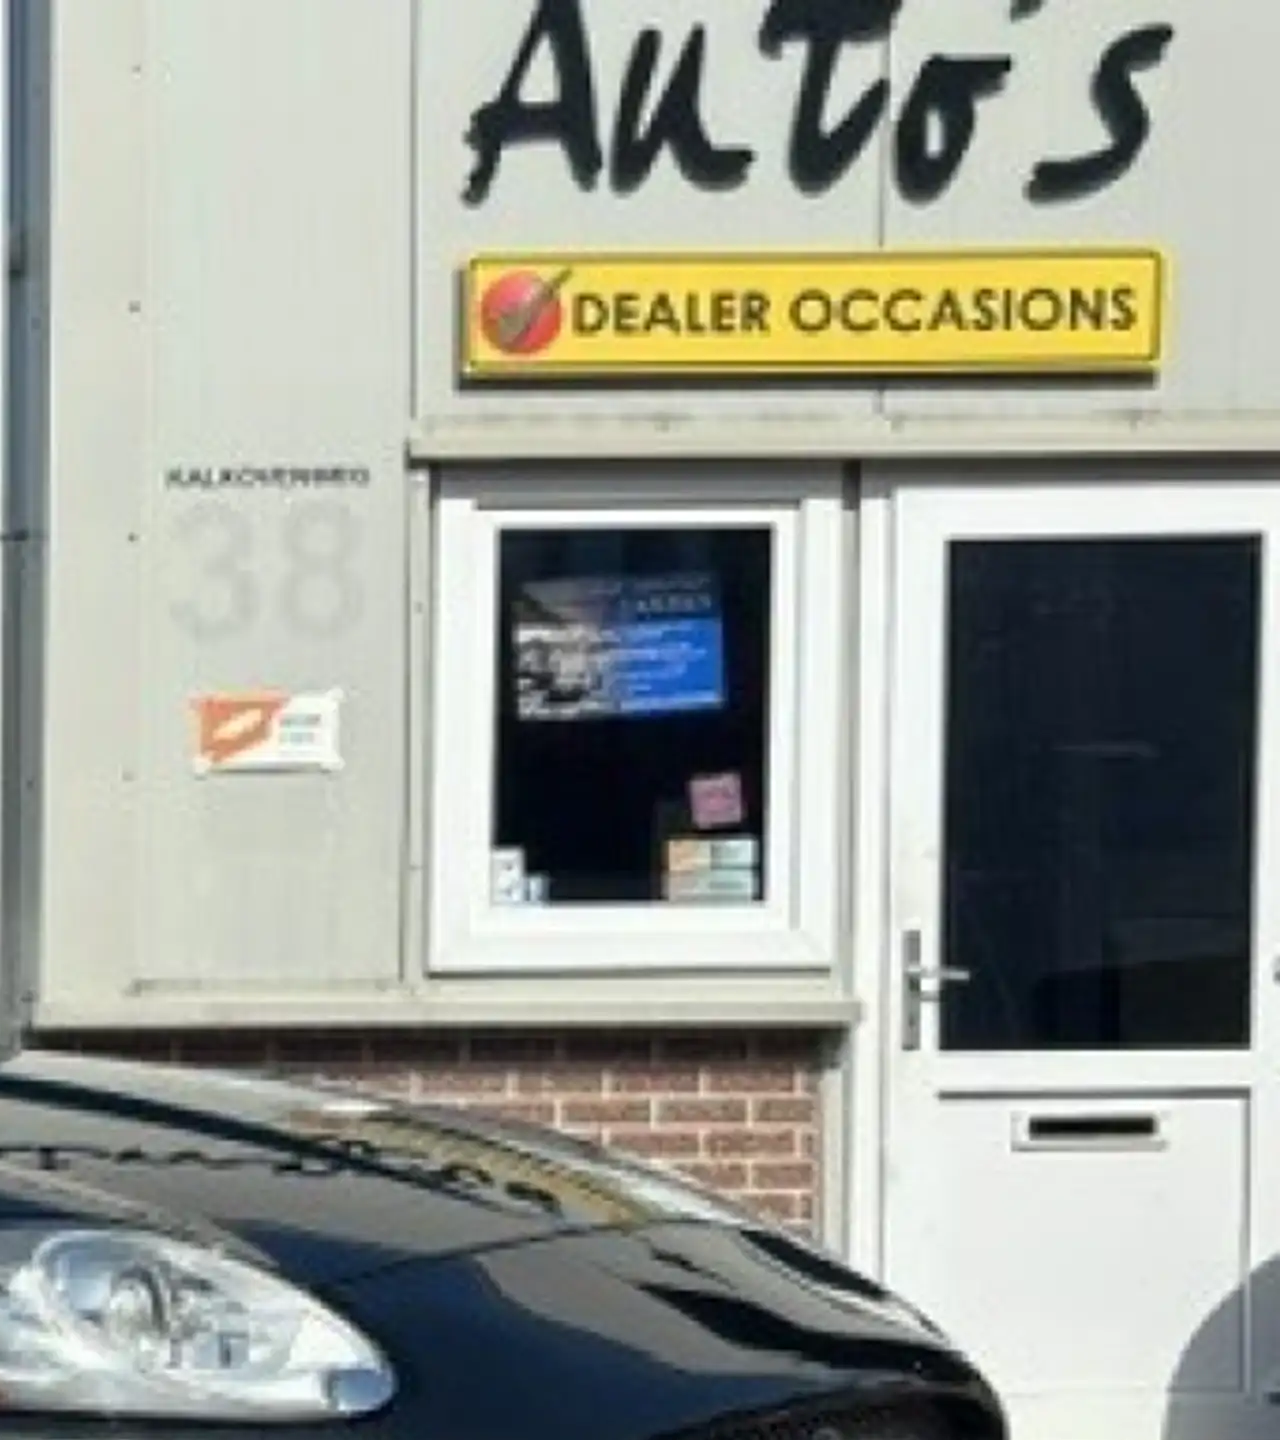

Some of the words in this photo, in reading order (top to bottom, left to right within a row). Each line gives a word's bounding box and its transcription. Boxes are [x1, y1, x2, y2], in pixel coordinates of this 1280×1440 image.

[572, 289, 770, 337] DEALER
[788, 285, 1139, 334] OCCASIONS
[168, 500, 366, 640] 38
